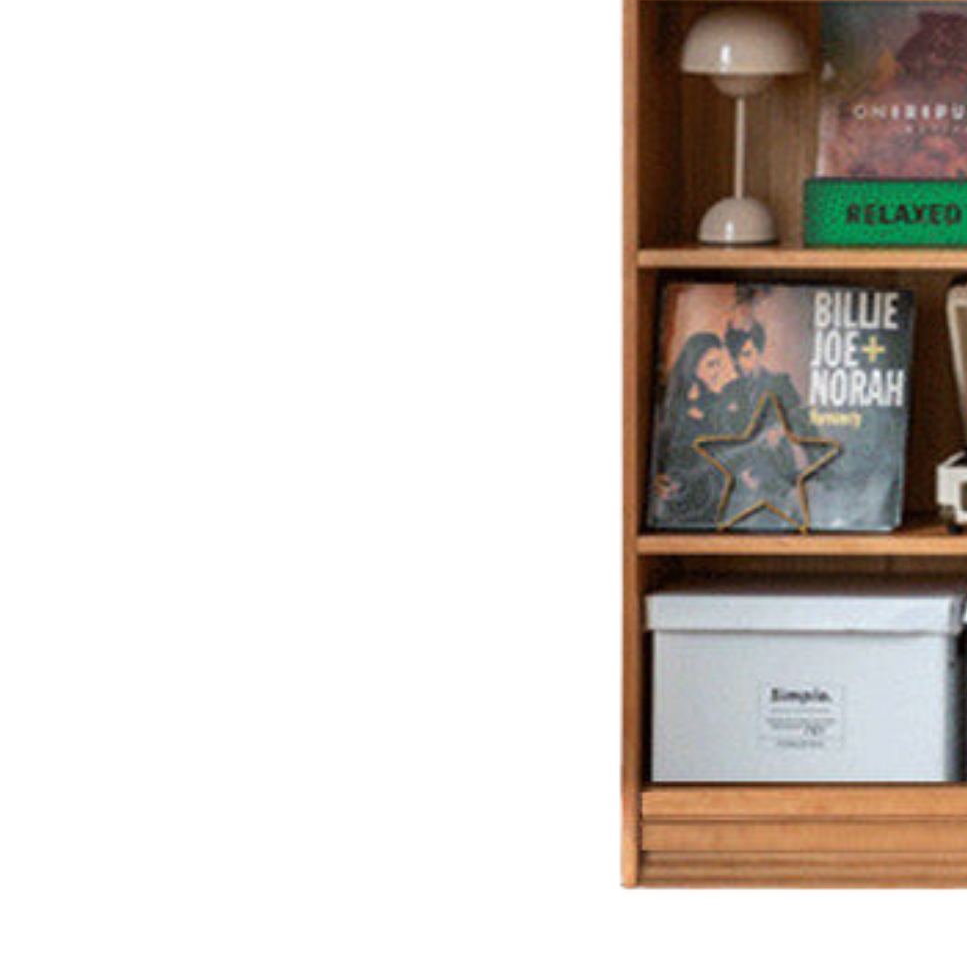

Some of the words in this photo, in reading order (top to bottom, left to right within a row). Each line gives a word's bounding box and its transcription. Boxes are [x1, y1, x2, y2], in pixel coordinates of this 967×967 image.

[845, 202, 963, 227] RELAXED
[814, 291, 900, 330] BILLIE
[809, 368, 906, 408] NORAH
